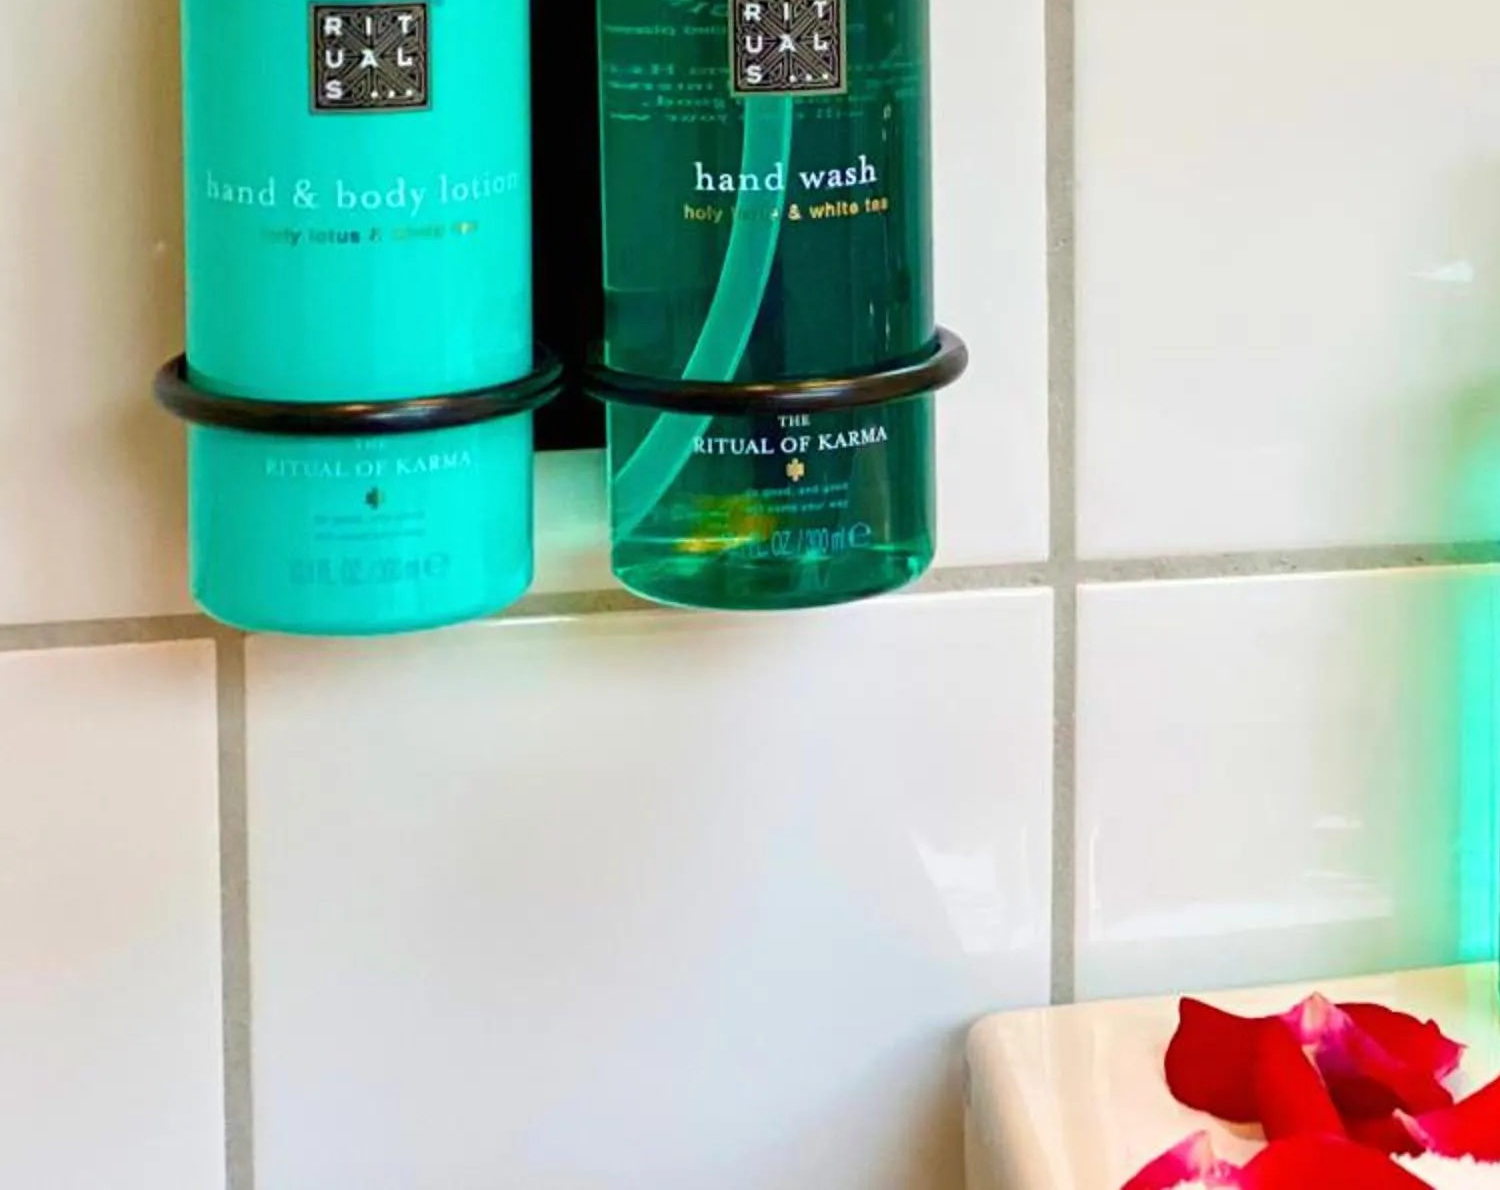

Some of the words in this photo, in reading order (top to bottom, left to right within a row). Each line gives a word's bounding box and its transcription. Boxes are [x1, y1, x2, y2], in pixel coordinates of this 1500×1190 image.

[694, 161, 784, 191] hand
[799, 155, 877, 188] wash
[204, 170, 276, 206] hand
[293, 179, 318, 208] &
[337, 178, 425, 217] body
[441, 170, 520, 204] lotion
[683, 203, 723, 223] holy
[788, 203, 803, 220] &
[809, 201, 859, 219] white
[777, 414, 810, 427] THE
[693, 435, 775, 455] RITUAL
[780, 436, 811, 453] OF
[818, 425, 888, 450] KARMA
[265, 456, 349, 476] RITUAL
[356, 459, 386, 477] OF
[397, 450, 471, 475] KARMA
